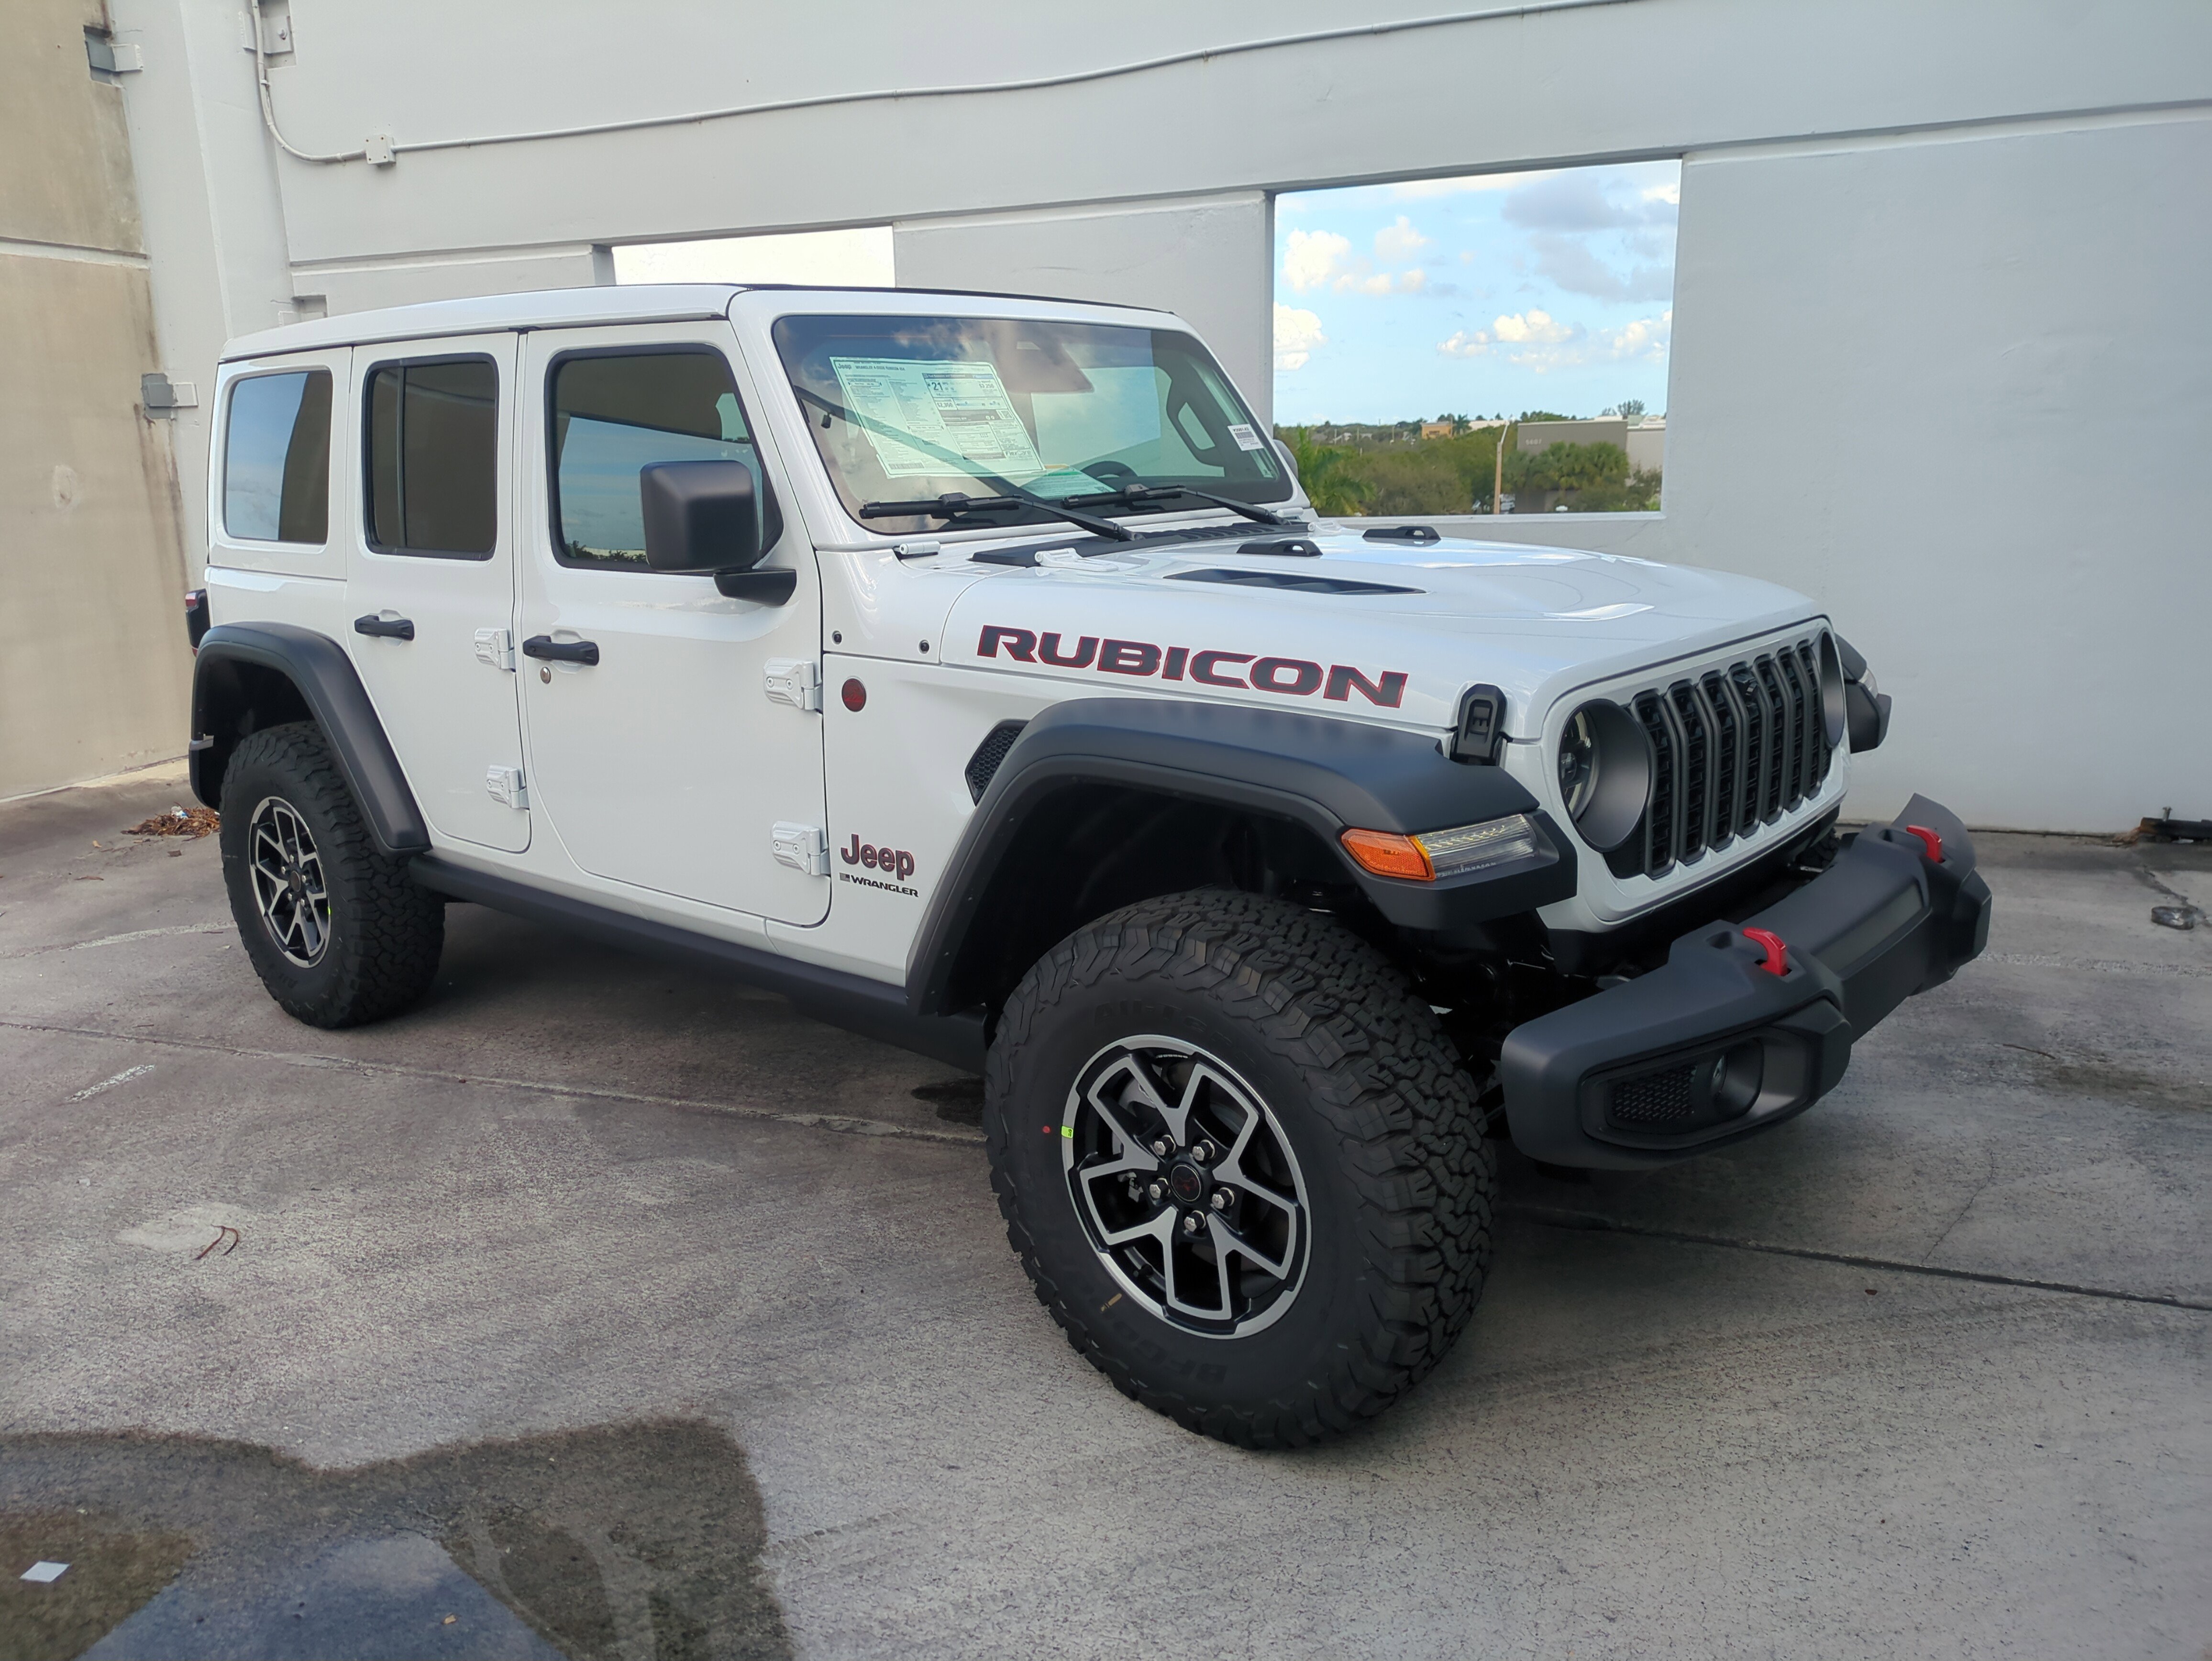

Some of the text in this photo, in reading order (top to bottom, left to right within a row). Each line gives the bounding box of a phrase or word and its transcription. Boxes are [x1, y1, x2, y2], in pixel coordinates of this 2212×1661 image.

[931, 382, 943, 390] 21
[977, 625, 1408, 709] RUBICON
[841, 833, 915, 881] Jeep
[851, 874, 918, 897] WRANGLER
